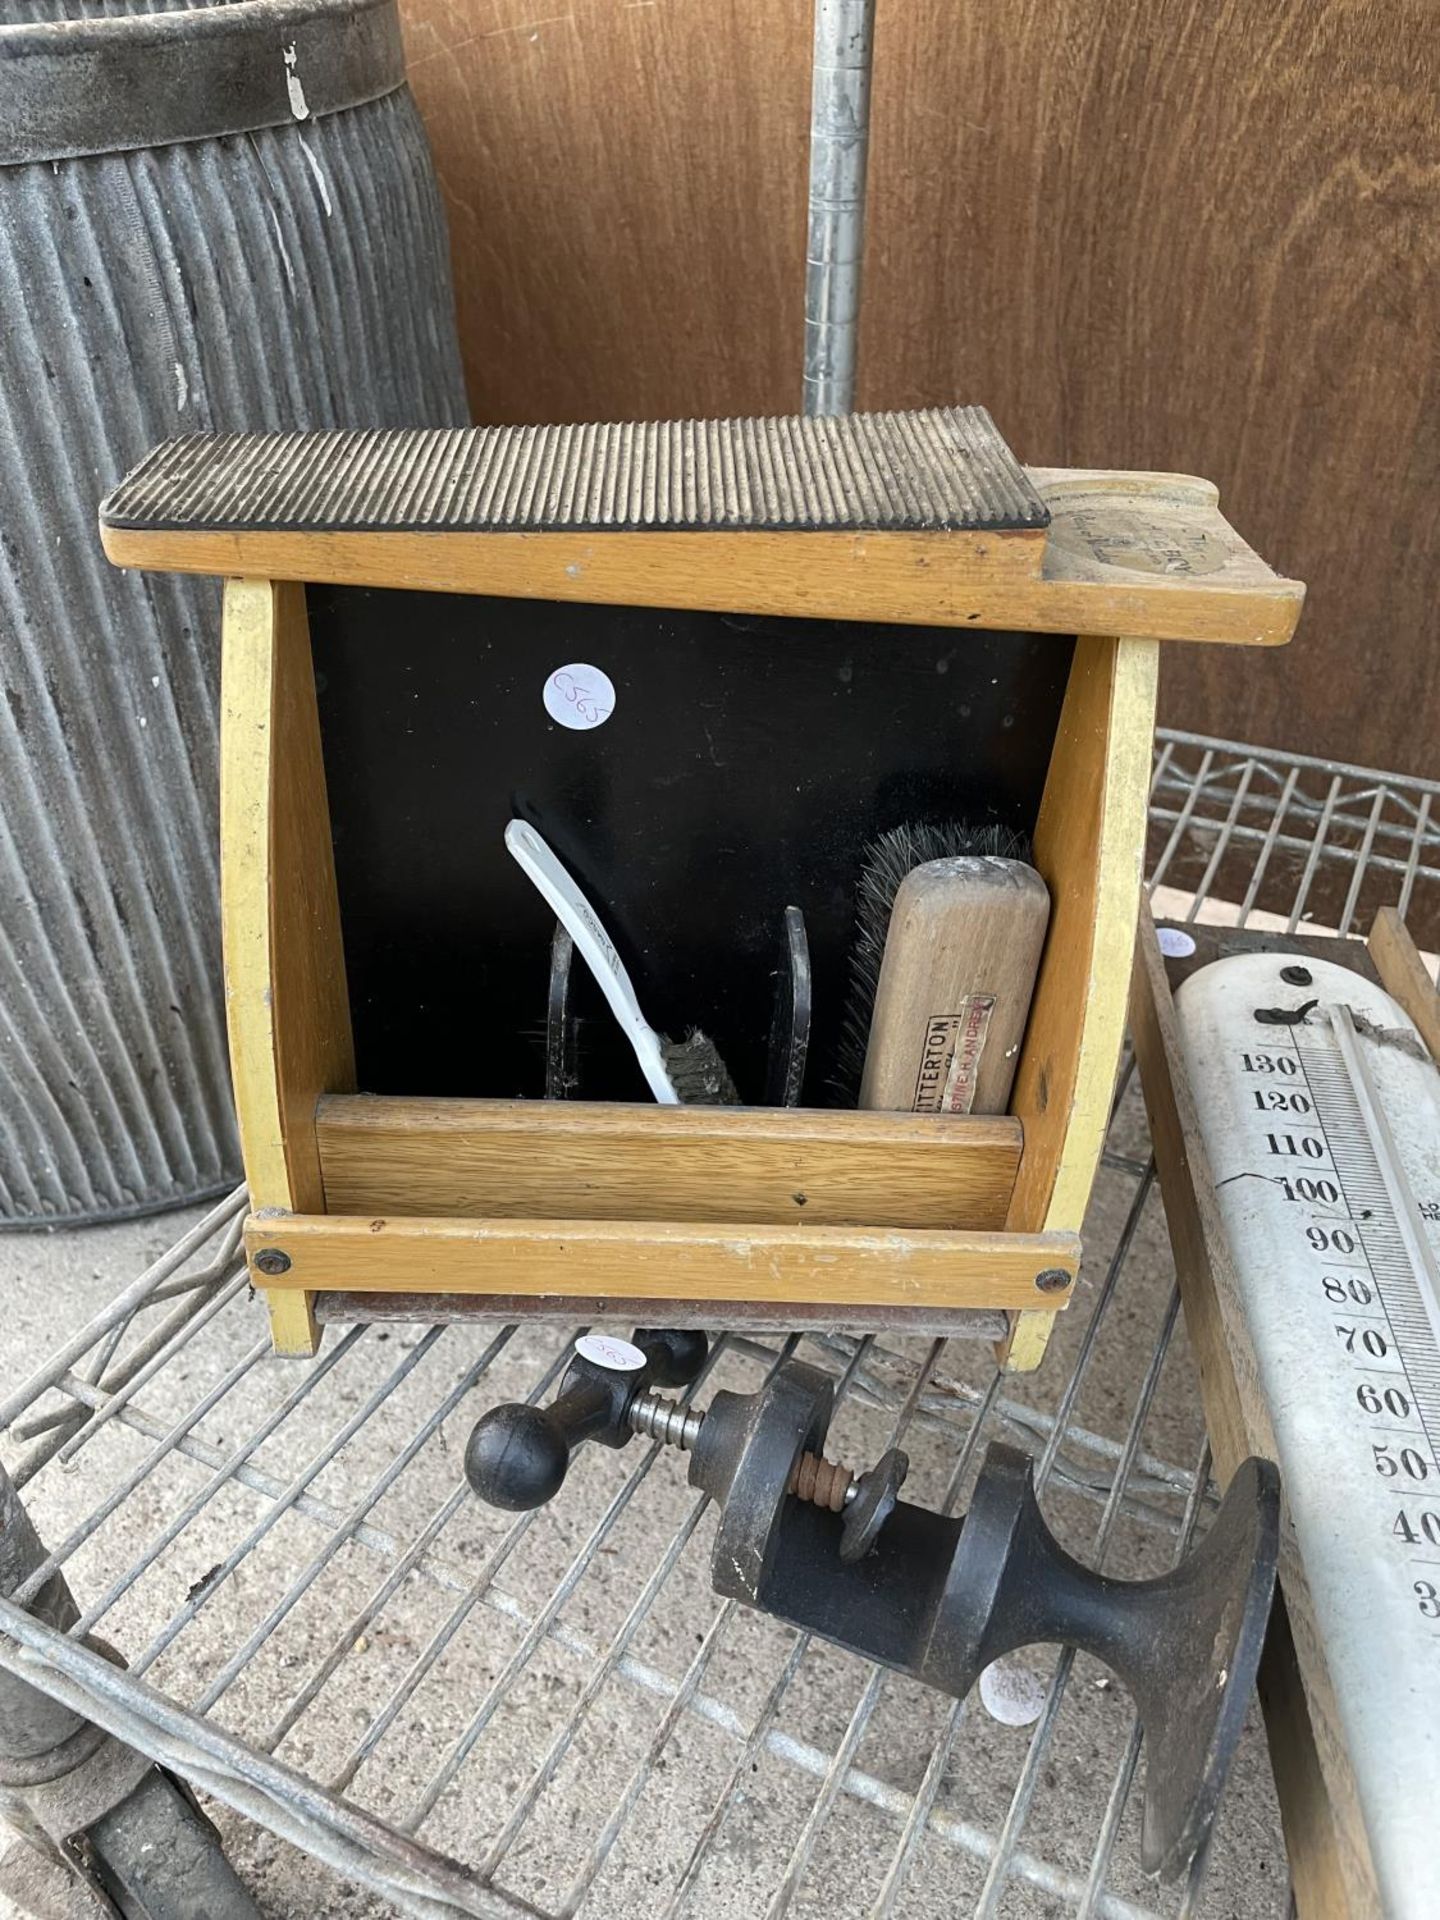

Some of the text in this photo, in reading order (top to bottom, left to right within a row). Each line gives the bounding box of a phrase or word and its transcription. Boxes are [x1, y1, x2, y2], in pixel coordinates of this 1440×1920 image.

[1240, 1053, 1297, 1076] 130
[1252, 1090, 1311, 1113] 120
[1263, 1133, 1324, 1159] 110
[1275, 1177, 1339, 1203] 100
[1305, 1226, 1355, 1254] 90
[1322, 1276, 1372, 1305] 80
[1335, 1325, 1387, 1358] 70
[1356, 1383, 1411, 1419] 60
[1371, 1444, 1428, 1481] 50
[1392, 1509, 1440, 1547] 40
